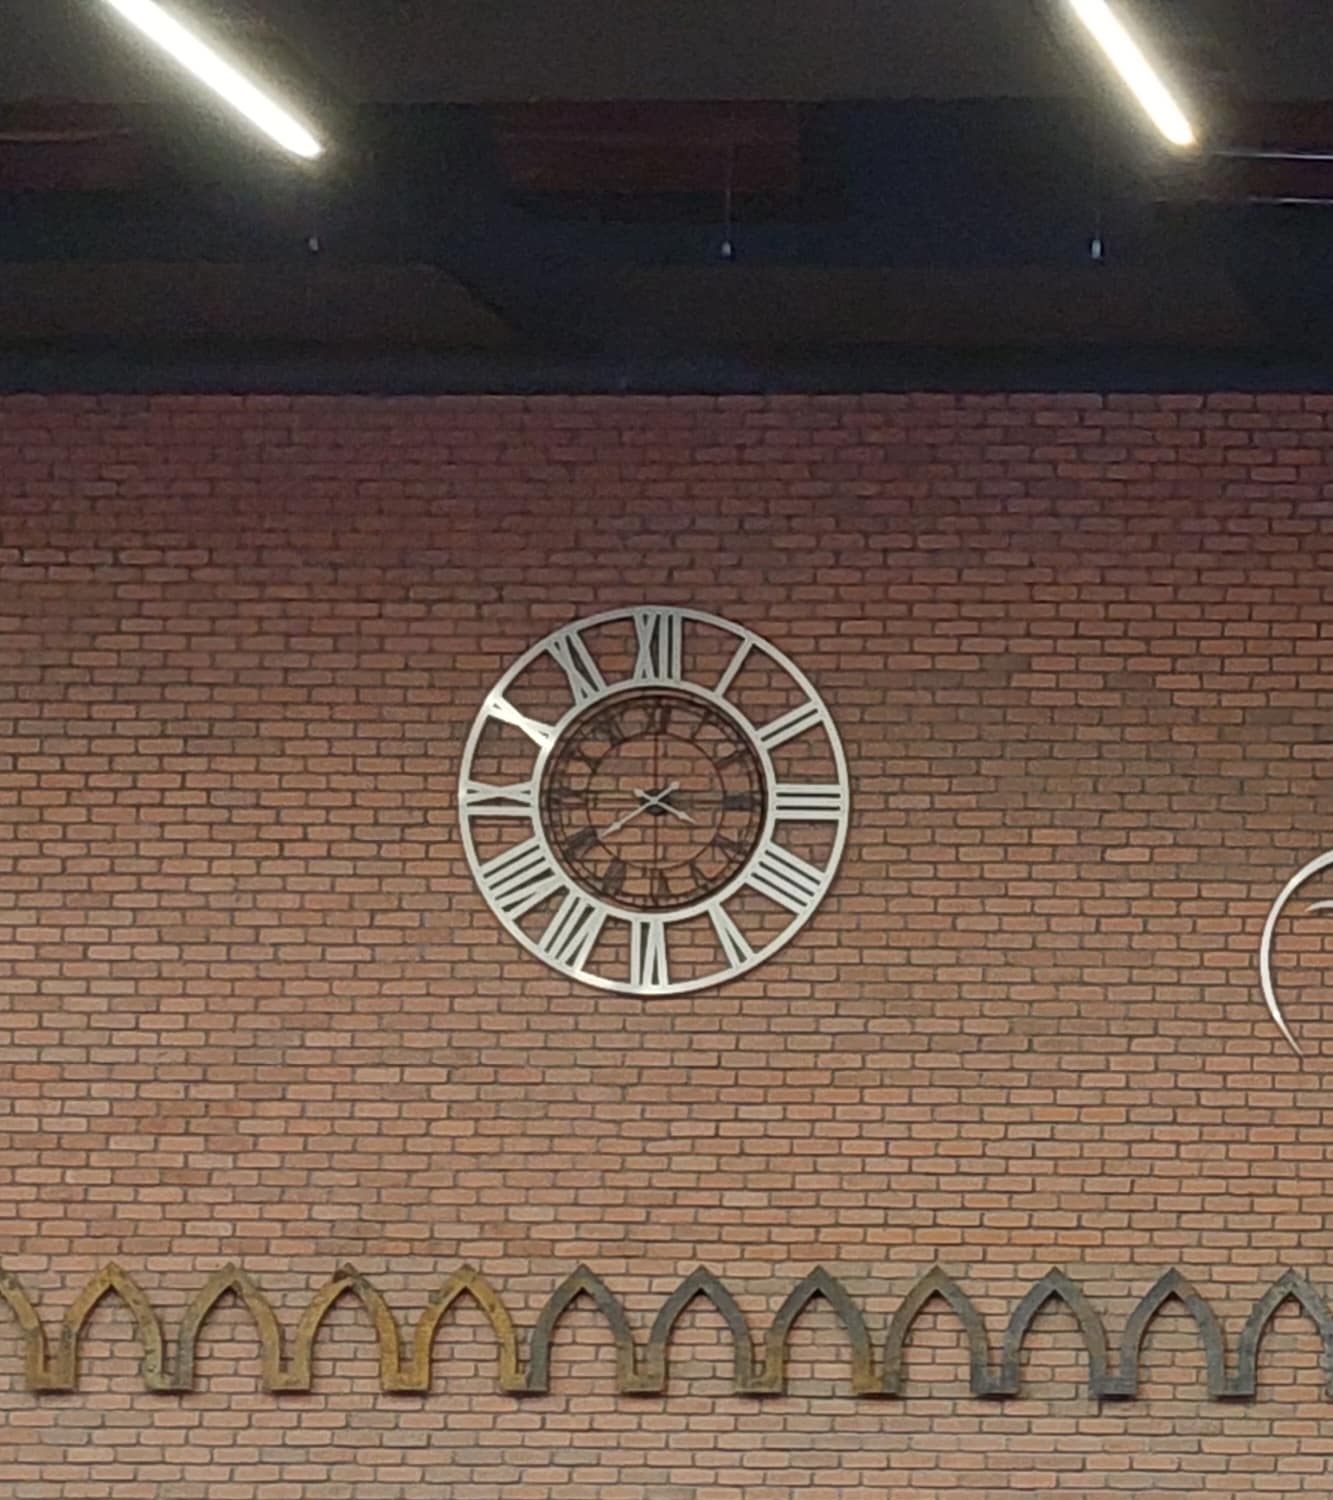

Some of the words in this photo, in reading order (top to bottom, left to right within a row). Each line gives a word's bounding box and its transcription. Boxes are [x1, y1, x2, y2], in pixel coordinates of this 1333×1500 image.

[546, 630, 606, 705] XI
[634, 612, 682, 682] XII
[714, 636, 755, 698] I
[487, 695, 554, 749] X
[756, 701, 823, 749] II
[464, 781, 536, 818] IX
[773, 783, 845, 819] III
[539, 894, 607, 971] VII
[631, 919, 669, 986] VI
[709, 902, 756, 968] V
